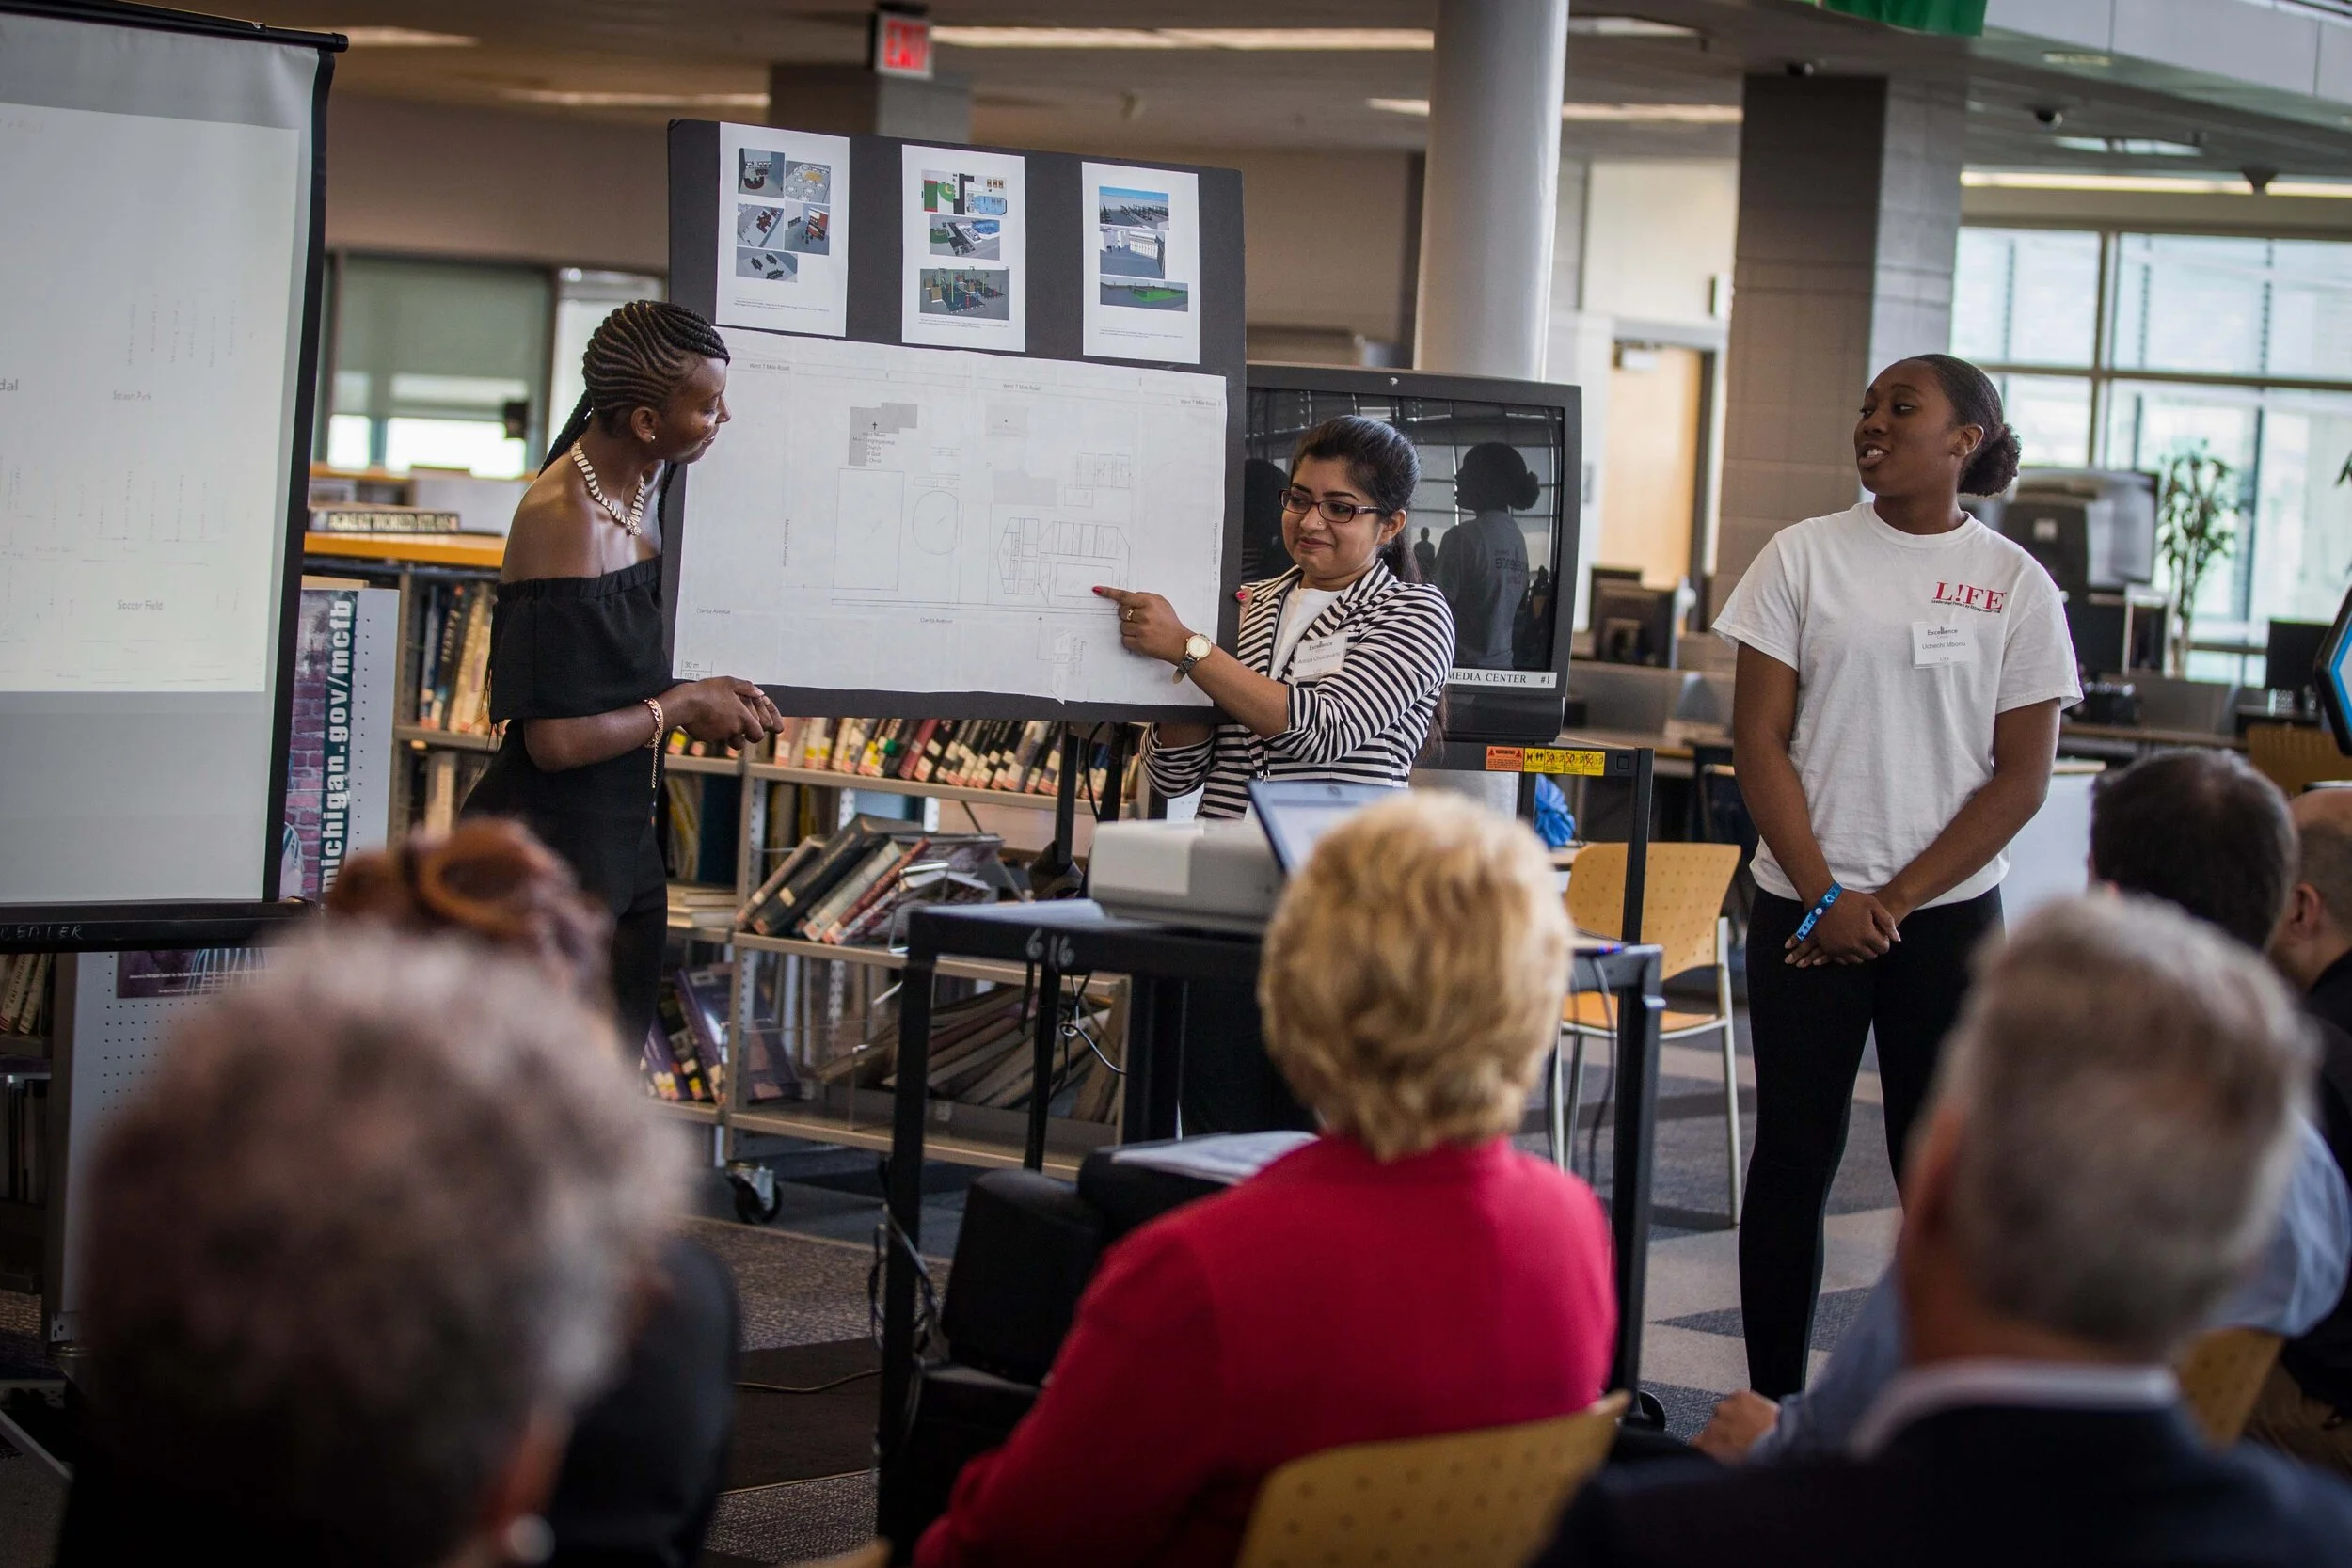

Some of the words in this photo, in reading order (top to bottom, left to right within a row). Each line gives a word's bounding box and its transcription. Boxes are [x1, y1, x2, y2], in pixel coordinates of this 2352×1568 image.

[1933, 581, 2008, 610] L!FE
[117, 599, 142, 610] Soccer
[145, 599, 164, 610] Field
[1927, 626, 1958, 636] Excellence
[1449, 671, 1482, 682] MEDIA
[1486, 672, 1526, 684] CENTER
[1540, 675, 1550, 684] #1
